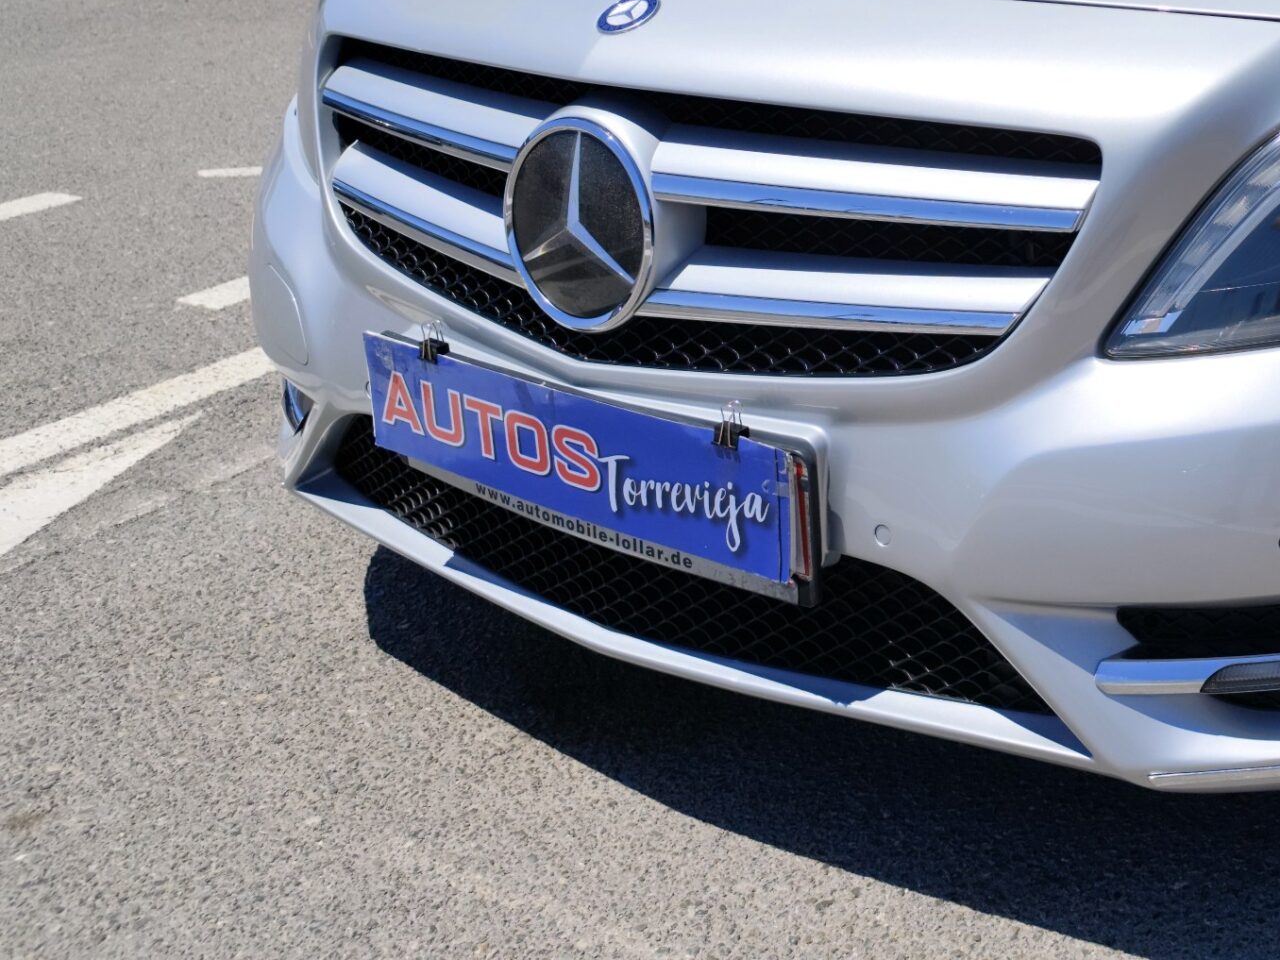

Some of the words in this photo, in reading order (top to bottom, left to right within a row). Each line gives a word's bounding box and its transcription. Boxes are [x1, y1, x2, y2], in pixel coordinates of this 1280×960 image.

[382, 371, 600, 492] AUTOS
[598, 455, 770, 552] Torrevieja
[475, 482, 693, 569] www.automobile-lollar.de
